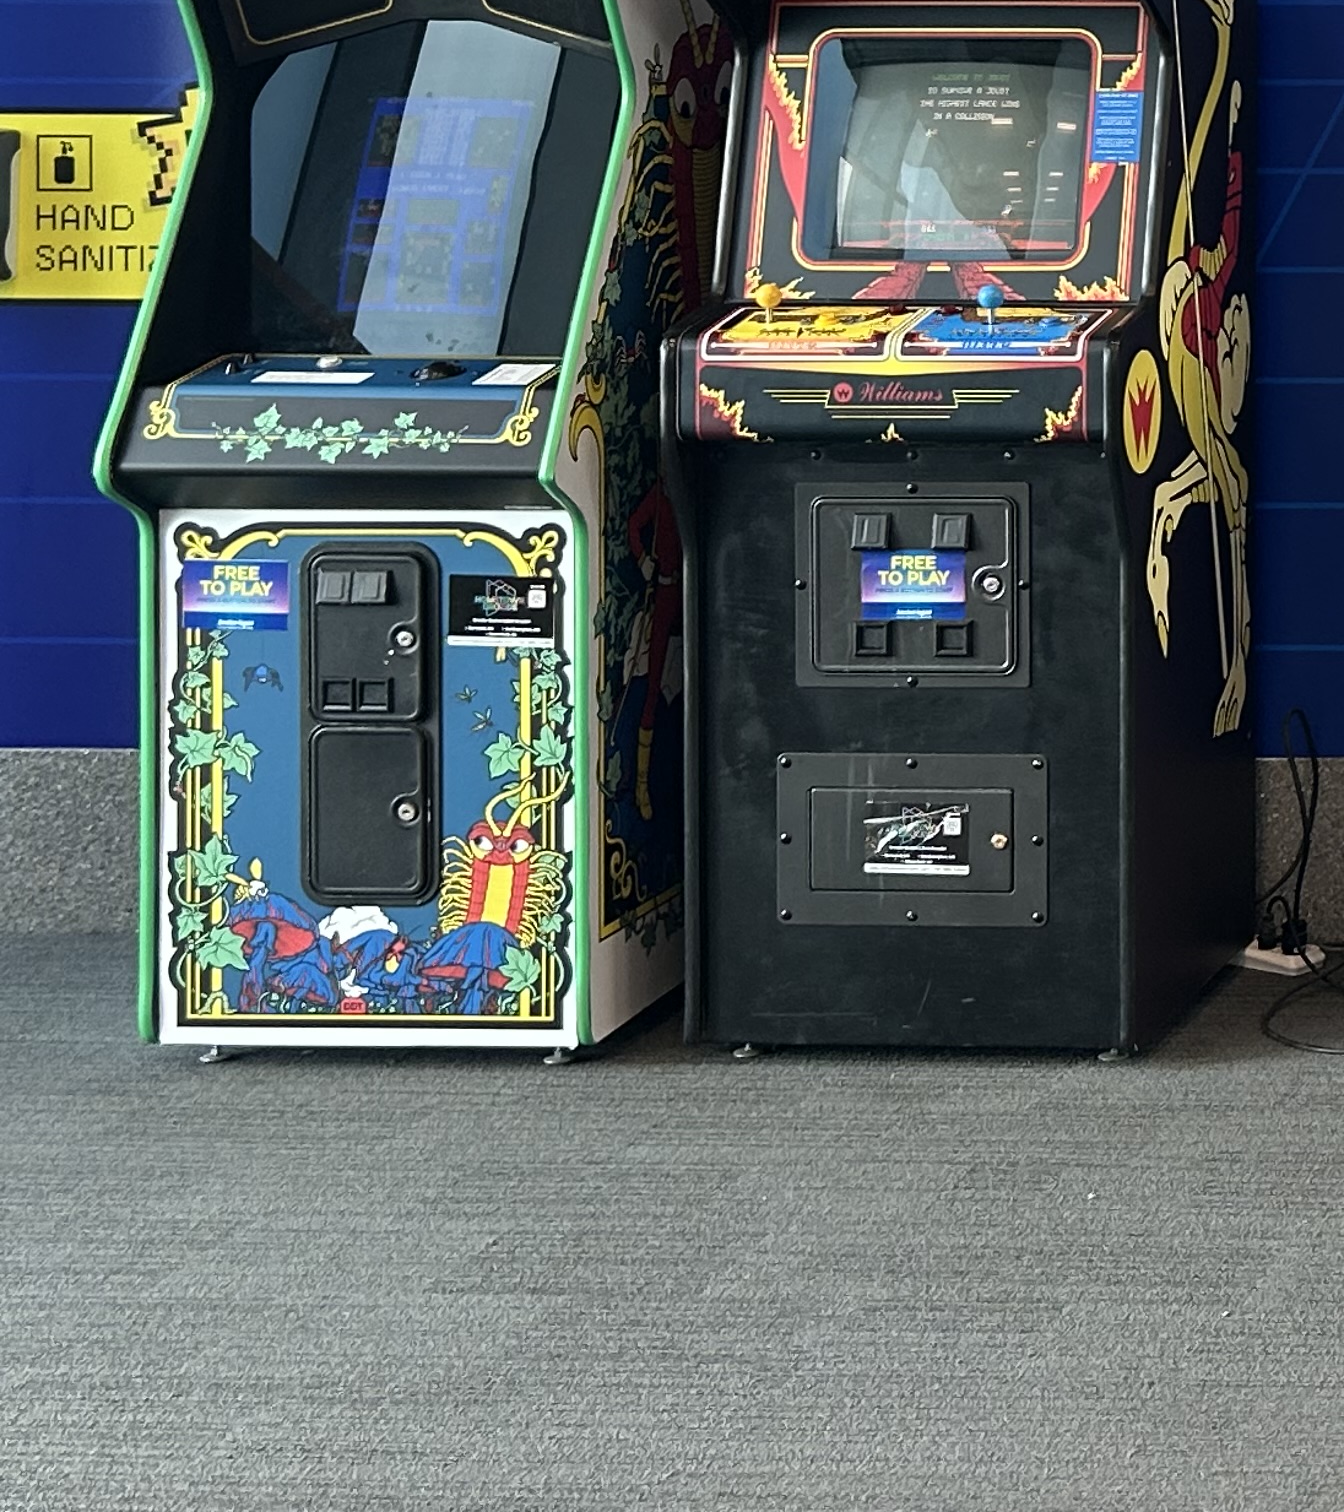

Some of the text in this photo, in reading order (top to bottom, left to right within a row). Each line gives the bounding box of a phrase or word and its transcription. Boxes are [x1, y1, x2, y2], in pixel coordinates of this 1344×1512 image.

[36, 204, 135, 231] HAND
[860, 381, 943, 402] Williams
[890, 555, 938, 570] FREE
[213, 565, 260, 581] FREE
[877, 570, 951, 586] TO PLAY
[199, 580, 273, 596] TO PLAY
